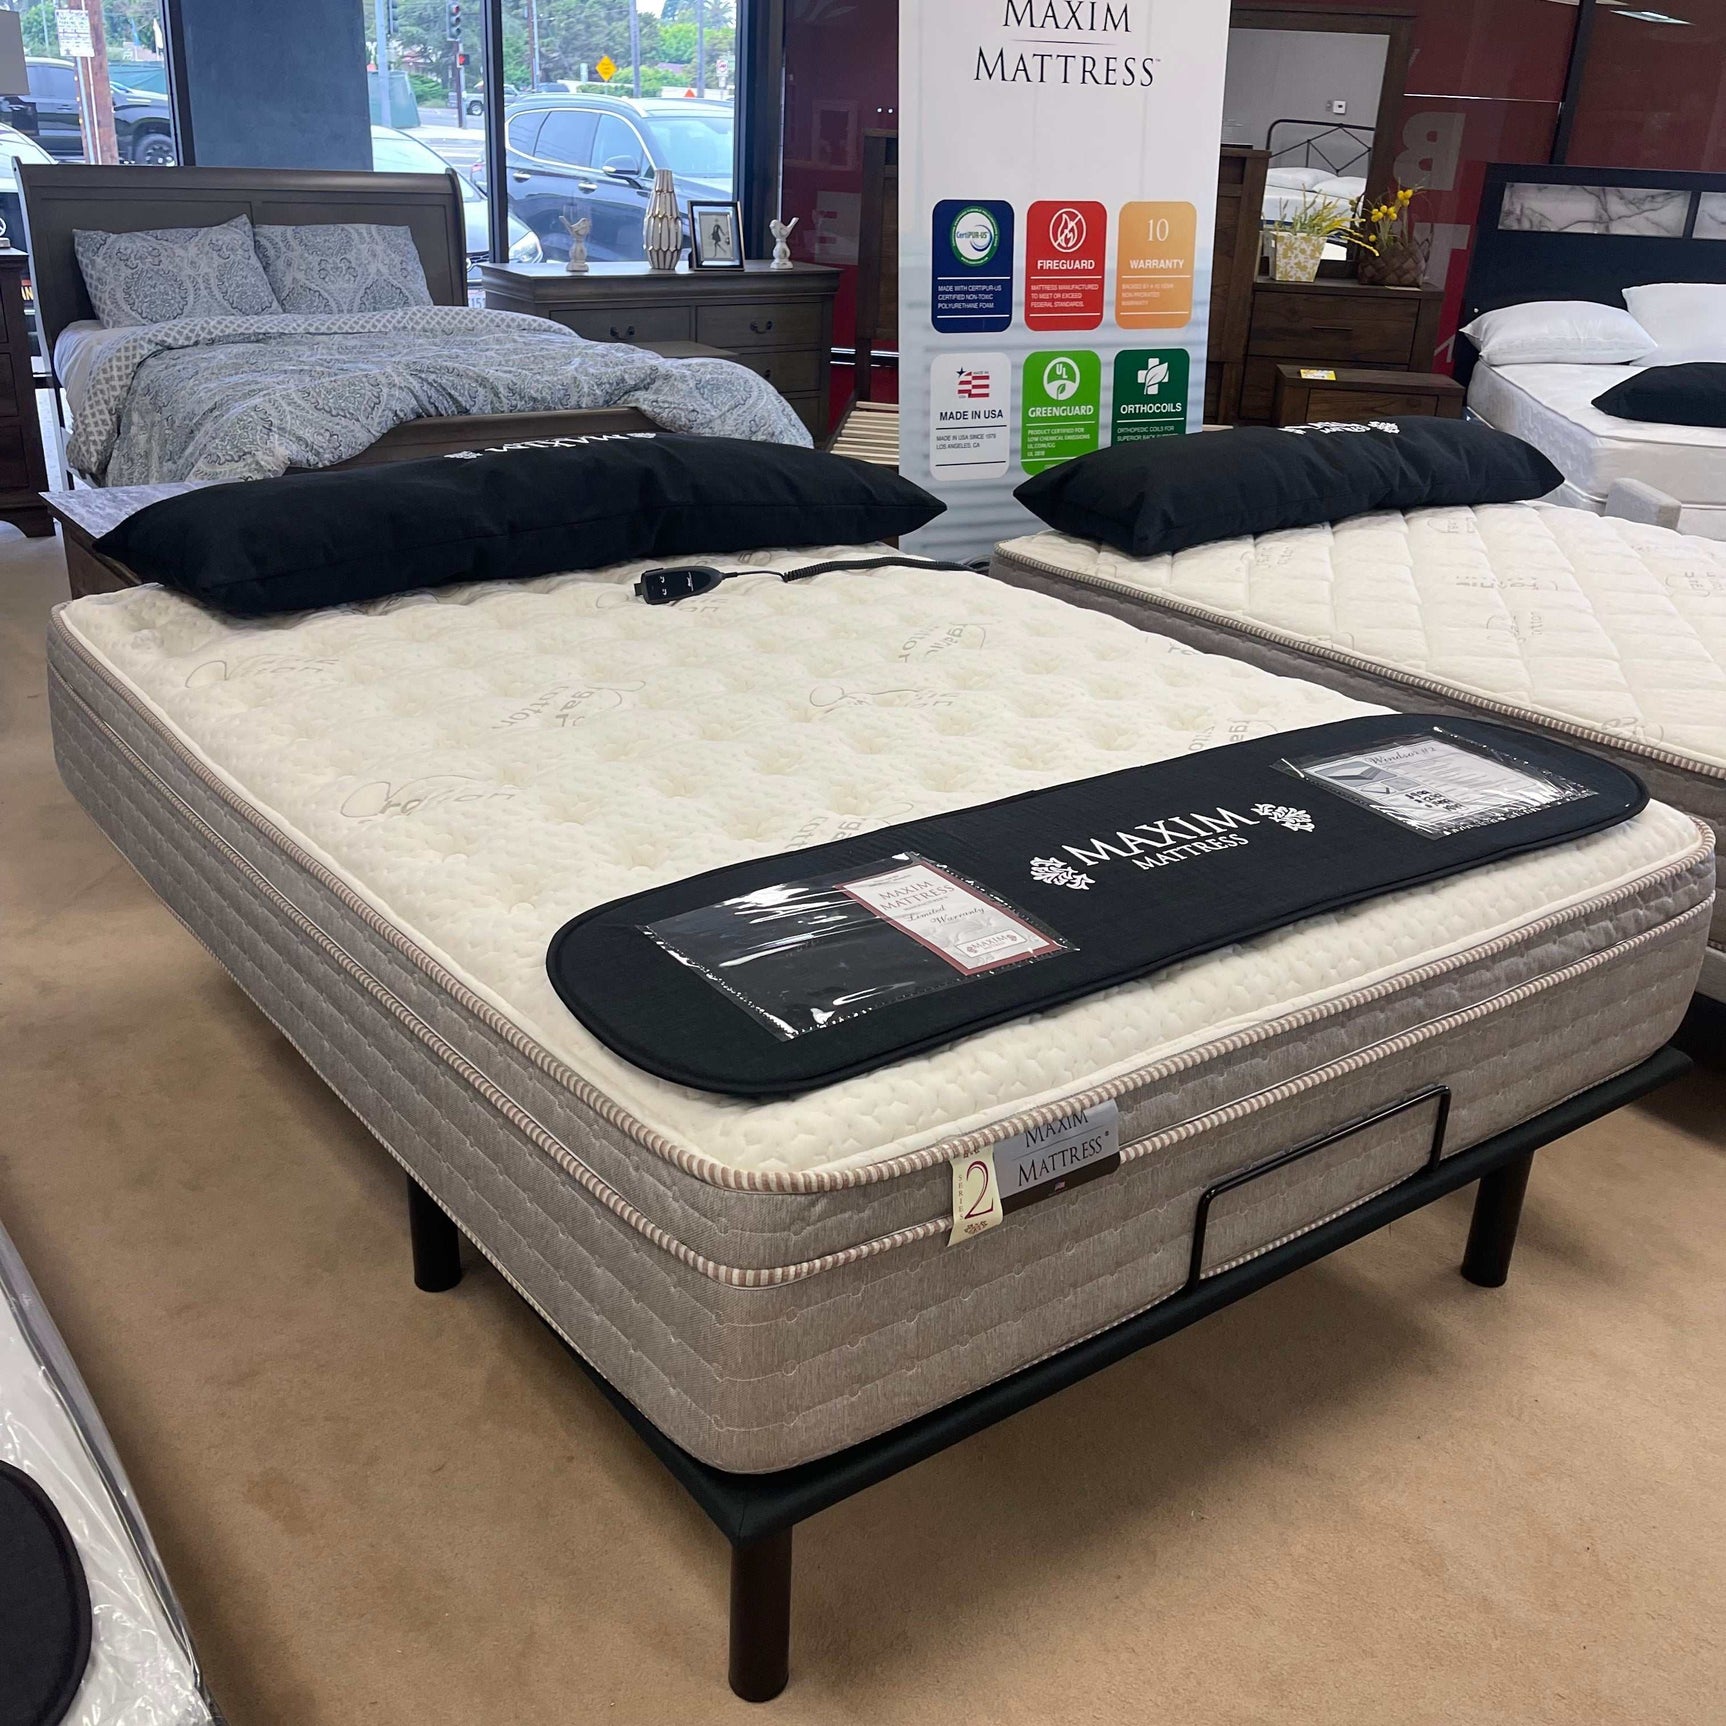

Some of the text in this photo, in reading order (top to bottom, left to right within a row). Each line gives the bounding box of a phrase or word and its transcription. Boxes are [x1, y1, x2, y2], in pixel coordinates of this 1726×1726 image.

[1002, 0, 1132, 32] MAXIM
[974, 46, 1155, 87] MATTRESS
[1147, 218, 1169, 241] 10
[1037, 259, 1095, 270] FIREGUARD
[1129, 259, 1184, 269] WARRANTY
[1056, 364, 1067, 378] UL
[939, 409, 1003, 421] MADE IN USA
[1028, 405, 1094, 417] GREENGUARD
[1120, 402, 1182, 414] ORTHOCOILS
[1062, 807, 1260, 866] MAXIM
[1131, 833, 1249, 870] MATTRESS
[878, 881, 933, 901] MAXIM
[880, 884, 955, 911] MATTRESS
[907, 905, 945, 921] Limited
[931, 907, 985, 924] Warranty
[1025, 1111, 1089, 1148] MAXIM
[964, 1160, 994, 1220] 2
